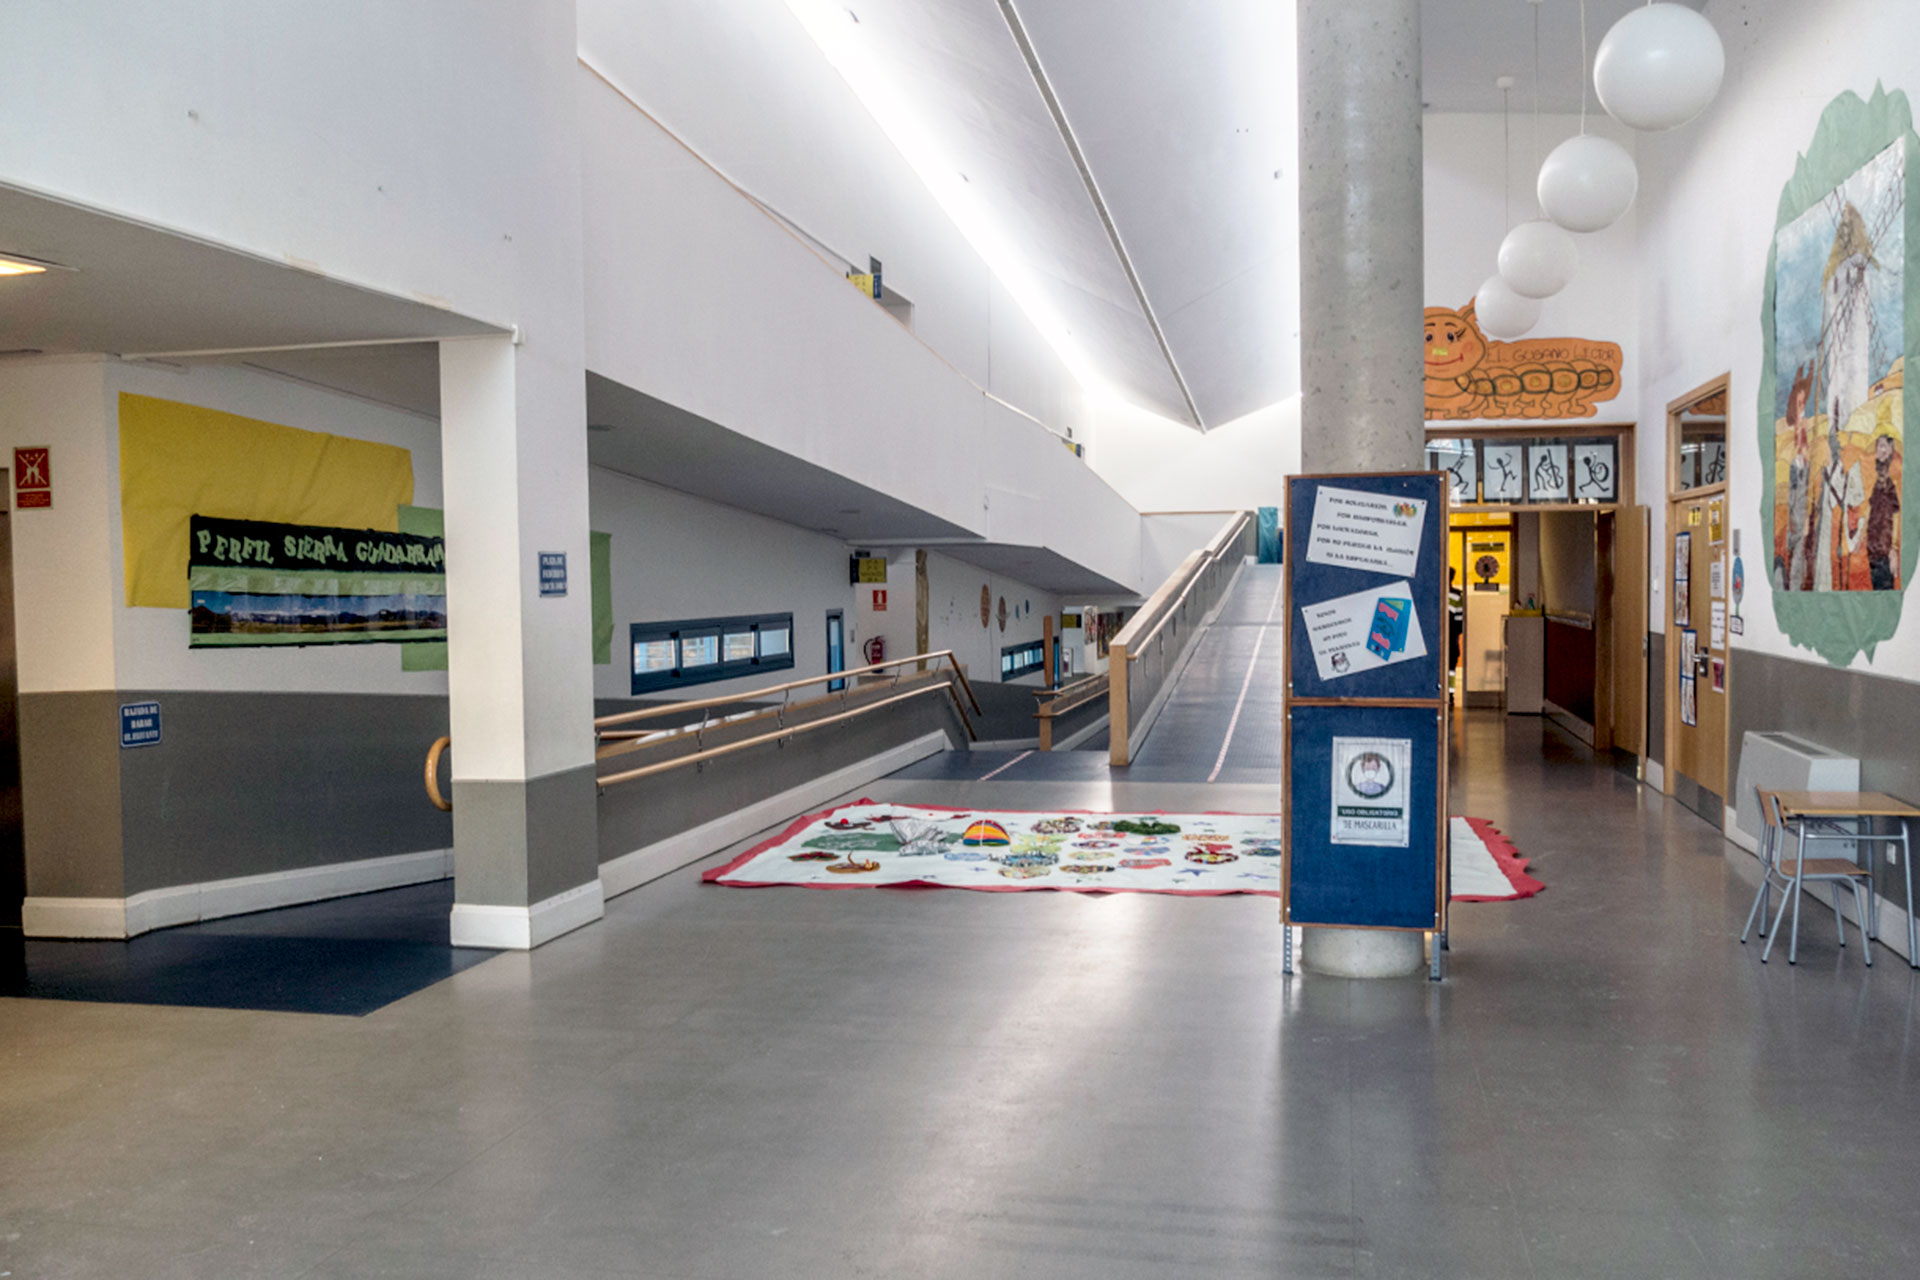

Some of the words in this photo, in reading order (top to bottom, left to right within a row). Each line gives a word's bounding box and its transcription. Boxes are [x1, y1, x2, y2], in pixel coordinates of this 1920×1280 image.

[196, 529, 274, 565] PERFIL
[284, 534, 348, 565] SIERRA
[1354, 820, 1397, 830] MASCARILLA
